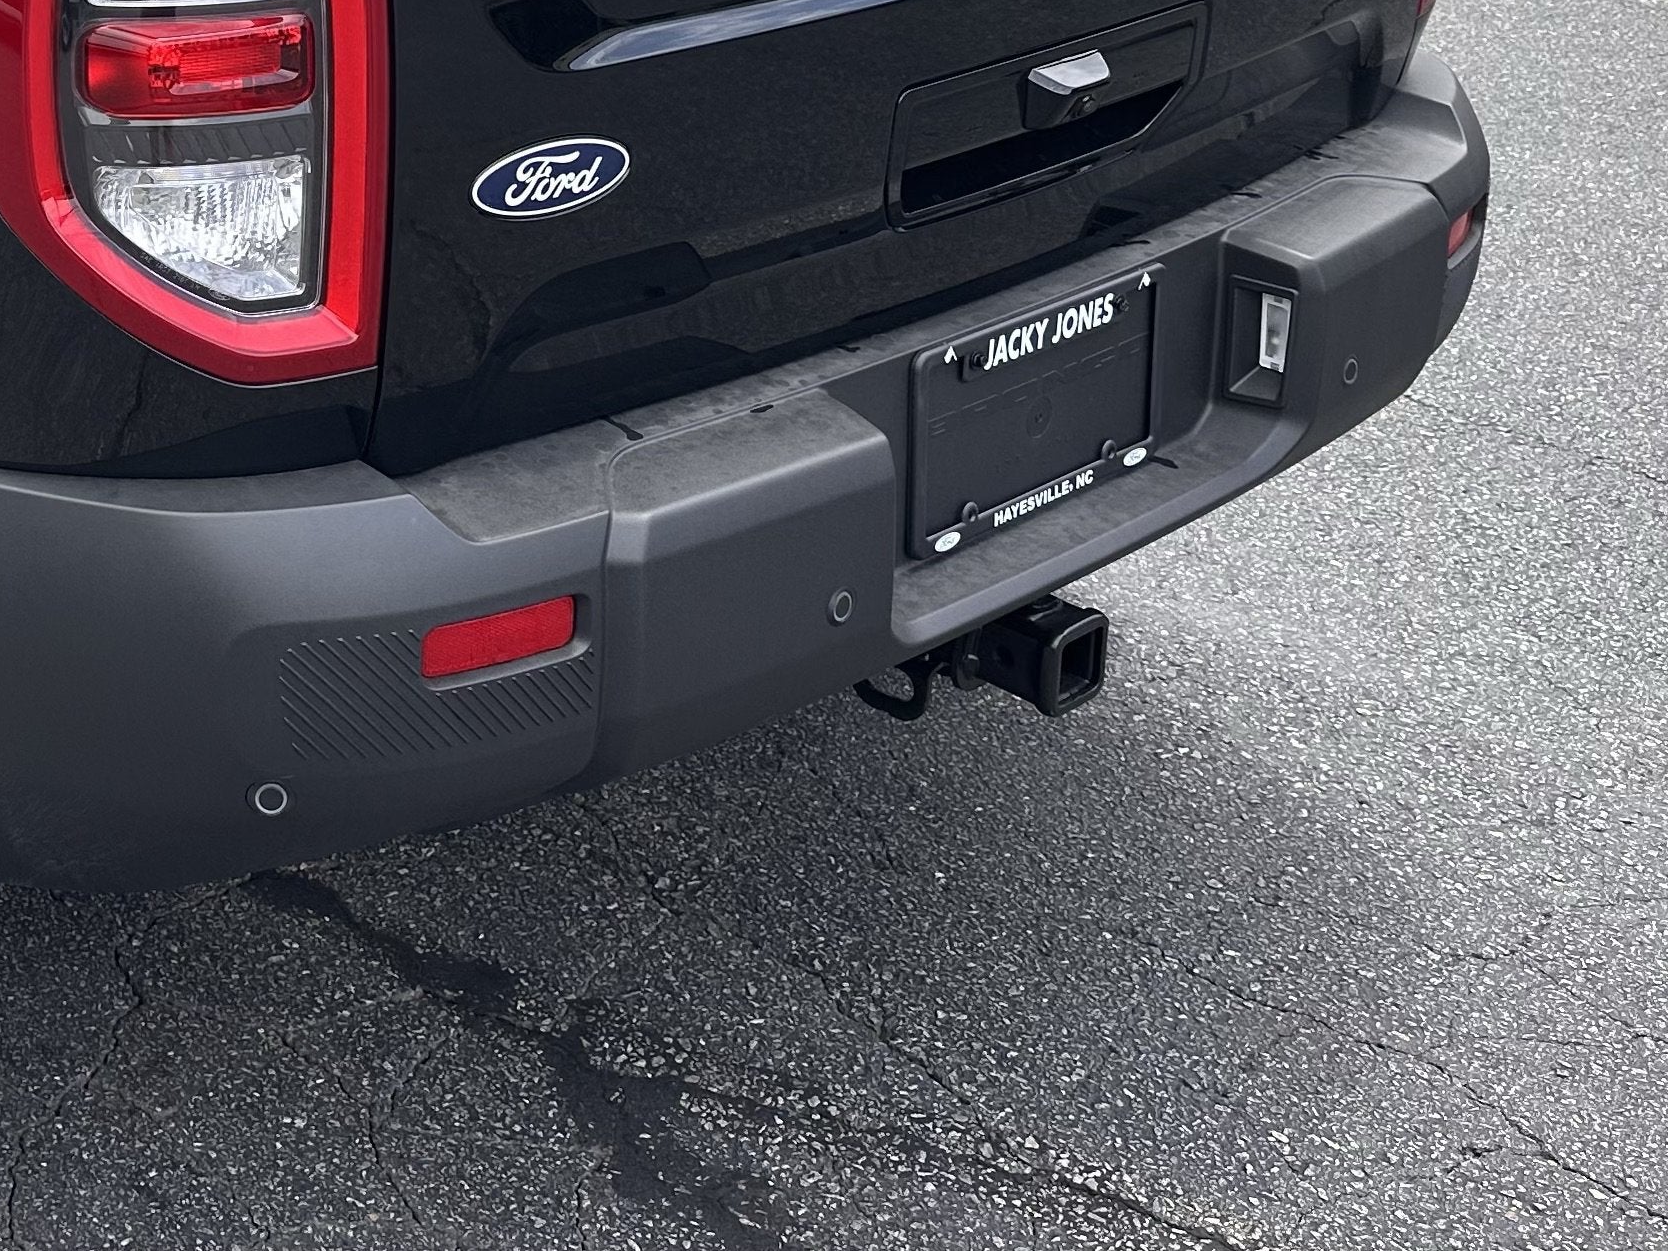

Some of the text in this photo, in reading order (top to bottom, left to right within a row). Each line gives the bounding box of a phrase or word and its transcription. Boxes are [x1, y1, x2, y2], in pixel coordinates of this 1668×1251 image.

[502, 148, 606, 208] Ford
[983, 291, 1116, 371] JACKY JONES
[993, 469, 1095, 528] HAYESVILLE, NC
